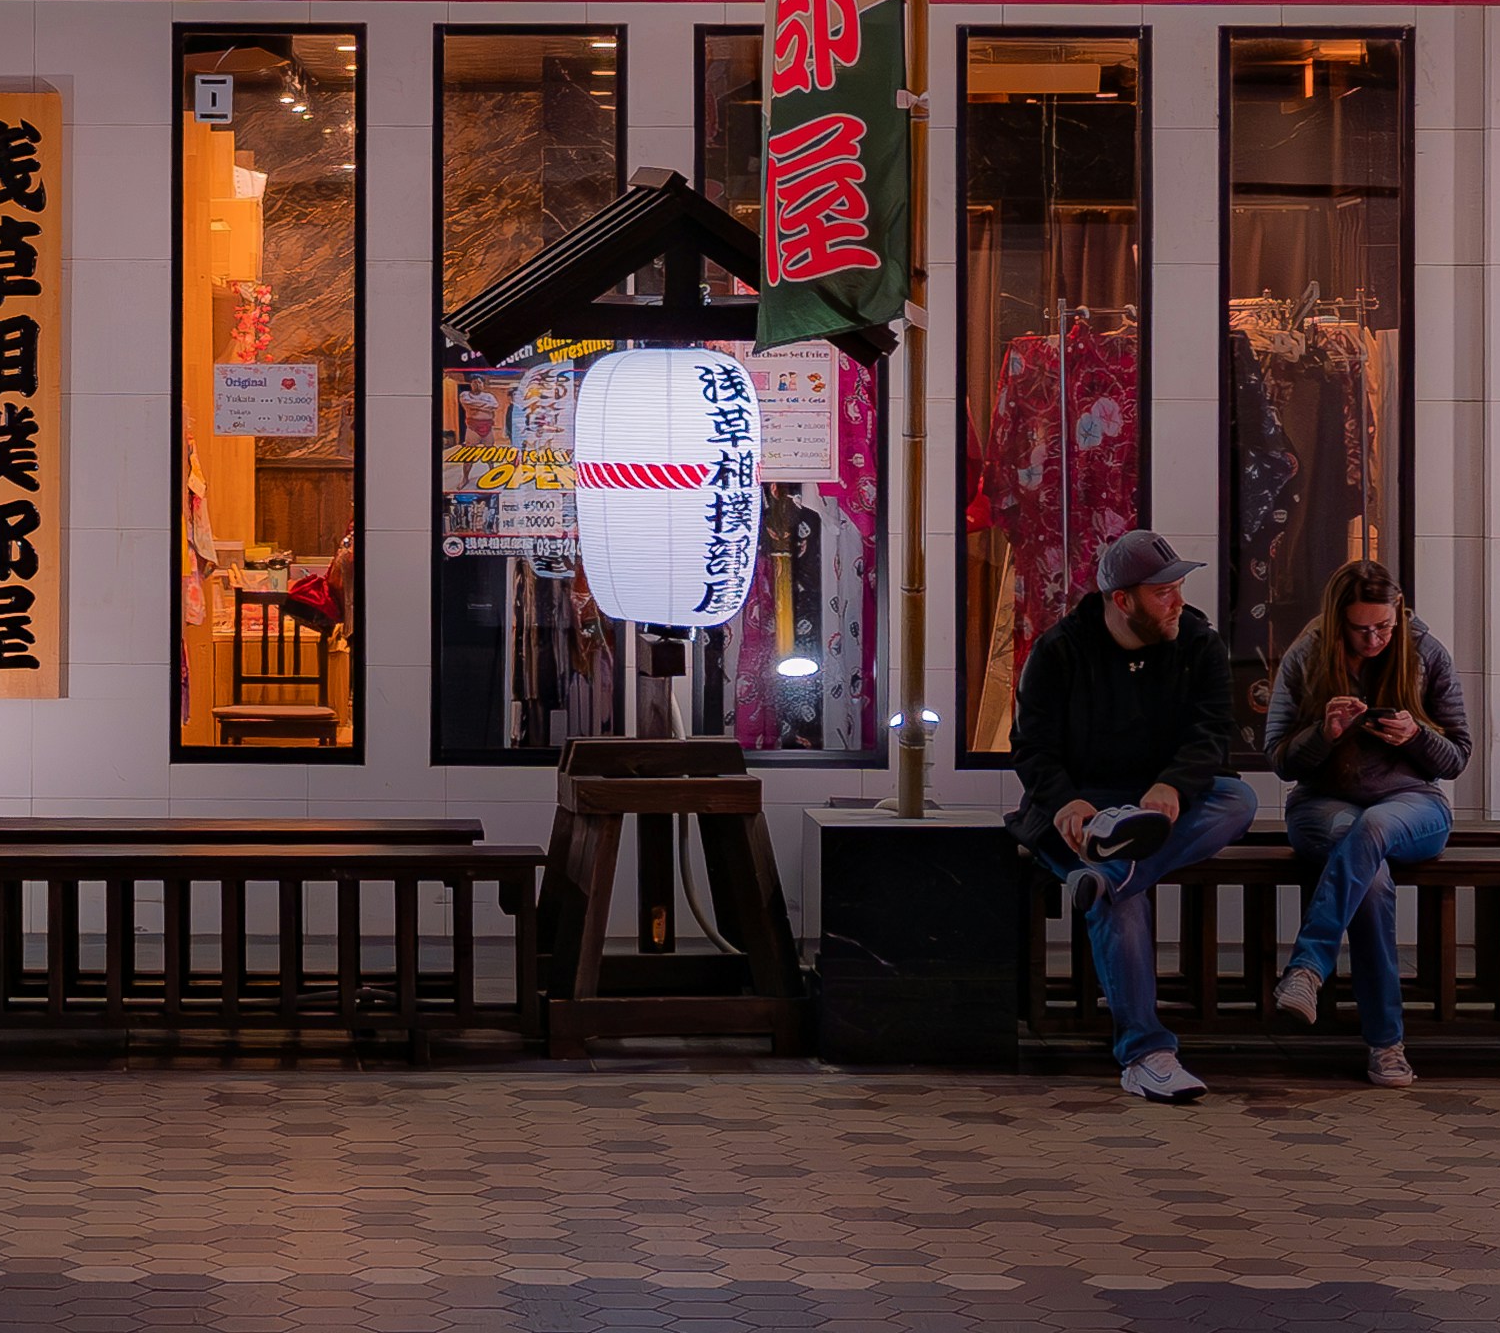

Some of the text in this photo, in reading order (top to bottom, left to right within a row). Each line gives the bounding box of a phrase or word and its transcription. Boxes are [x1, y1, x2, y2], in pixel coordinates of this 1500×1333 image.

[225, 377, 267, 389] Original
[477, 464, 578, 490] OPEN
[693, 365, 758, 616] 浅草相撲部屋
